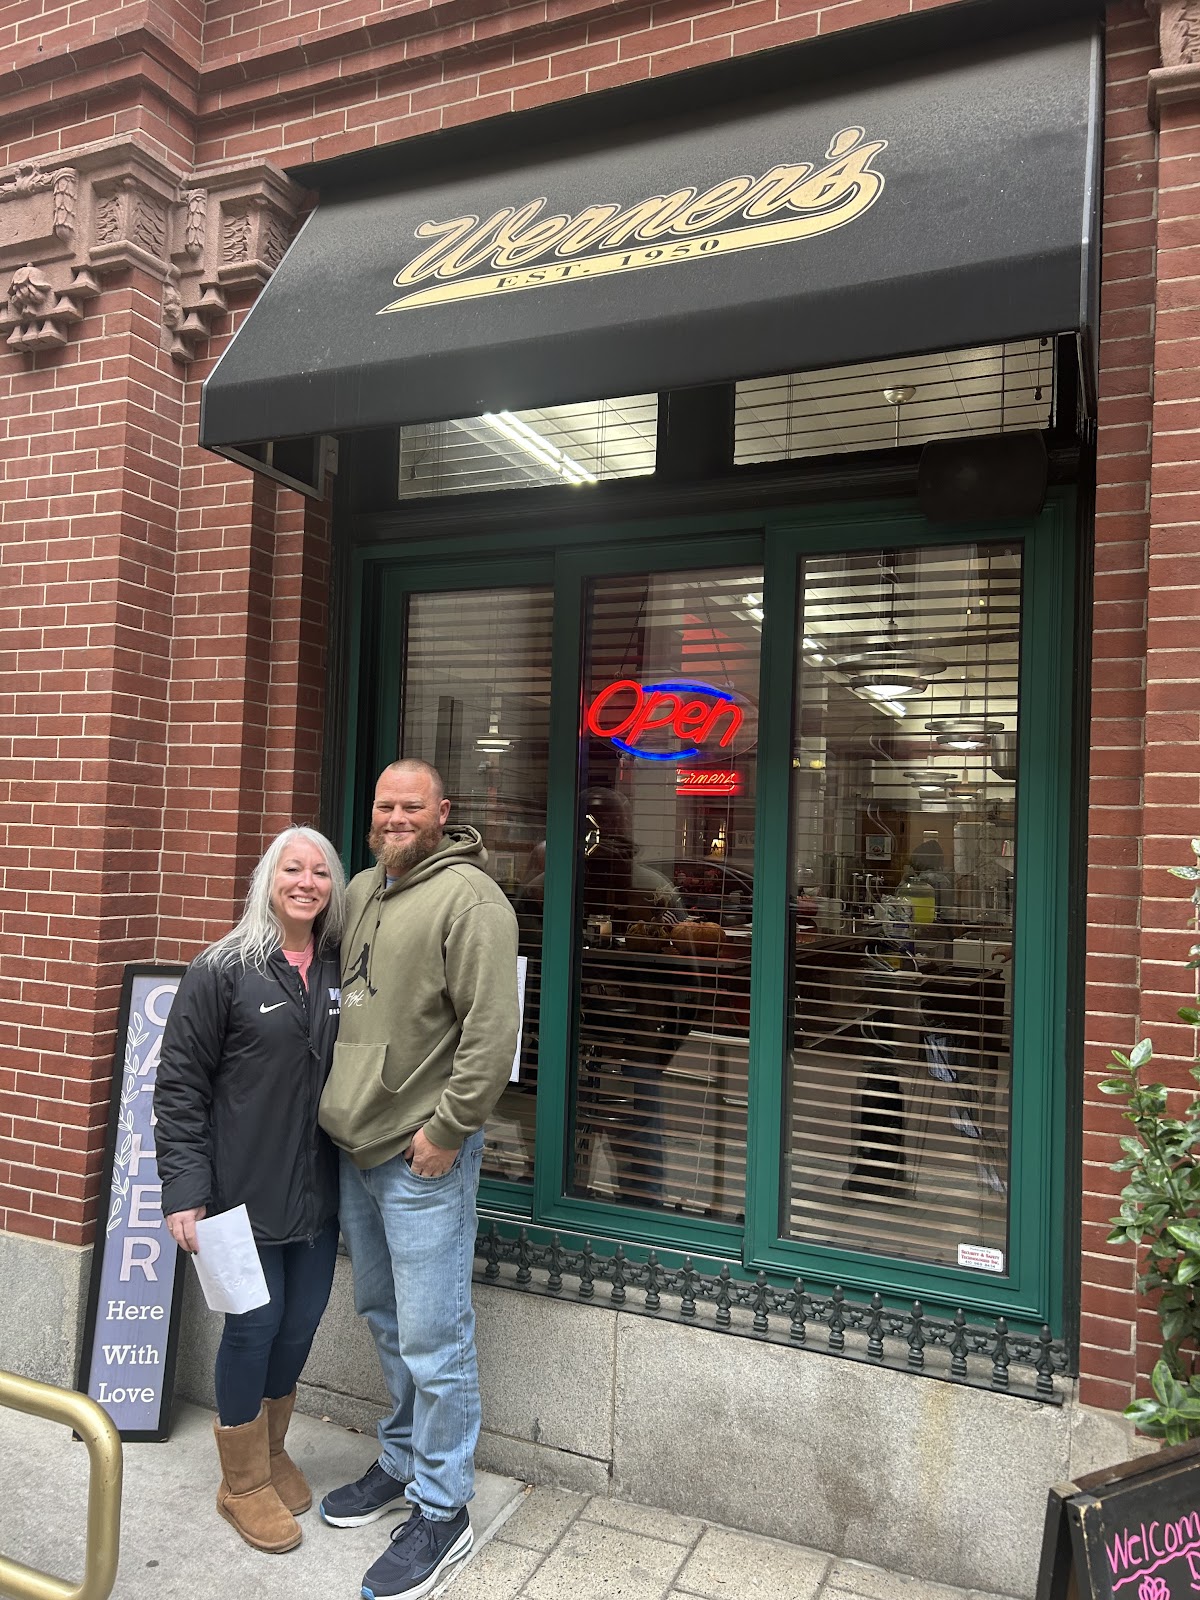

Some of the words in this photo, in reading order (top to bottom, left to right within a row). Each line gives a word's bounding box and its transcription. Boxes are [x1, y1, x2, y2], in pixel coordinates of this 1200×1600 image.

[393, 126, 888, 287] Werner's
[495, 263, 591, 289] EST.
[620, 238, 720, 267] 1950
[587, 680, 745, 748] Open
[106, 1300, 164, 1320] Here
[102, 1344, 159, 1365] With
[97, 1382, 154, 1403] Love
